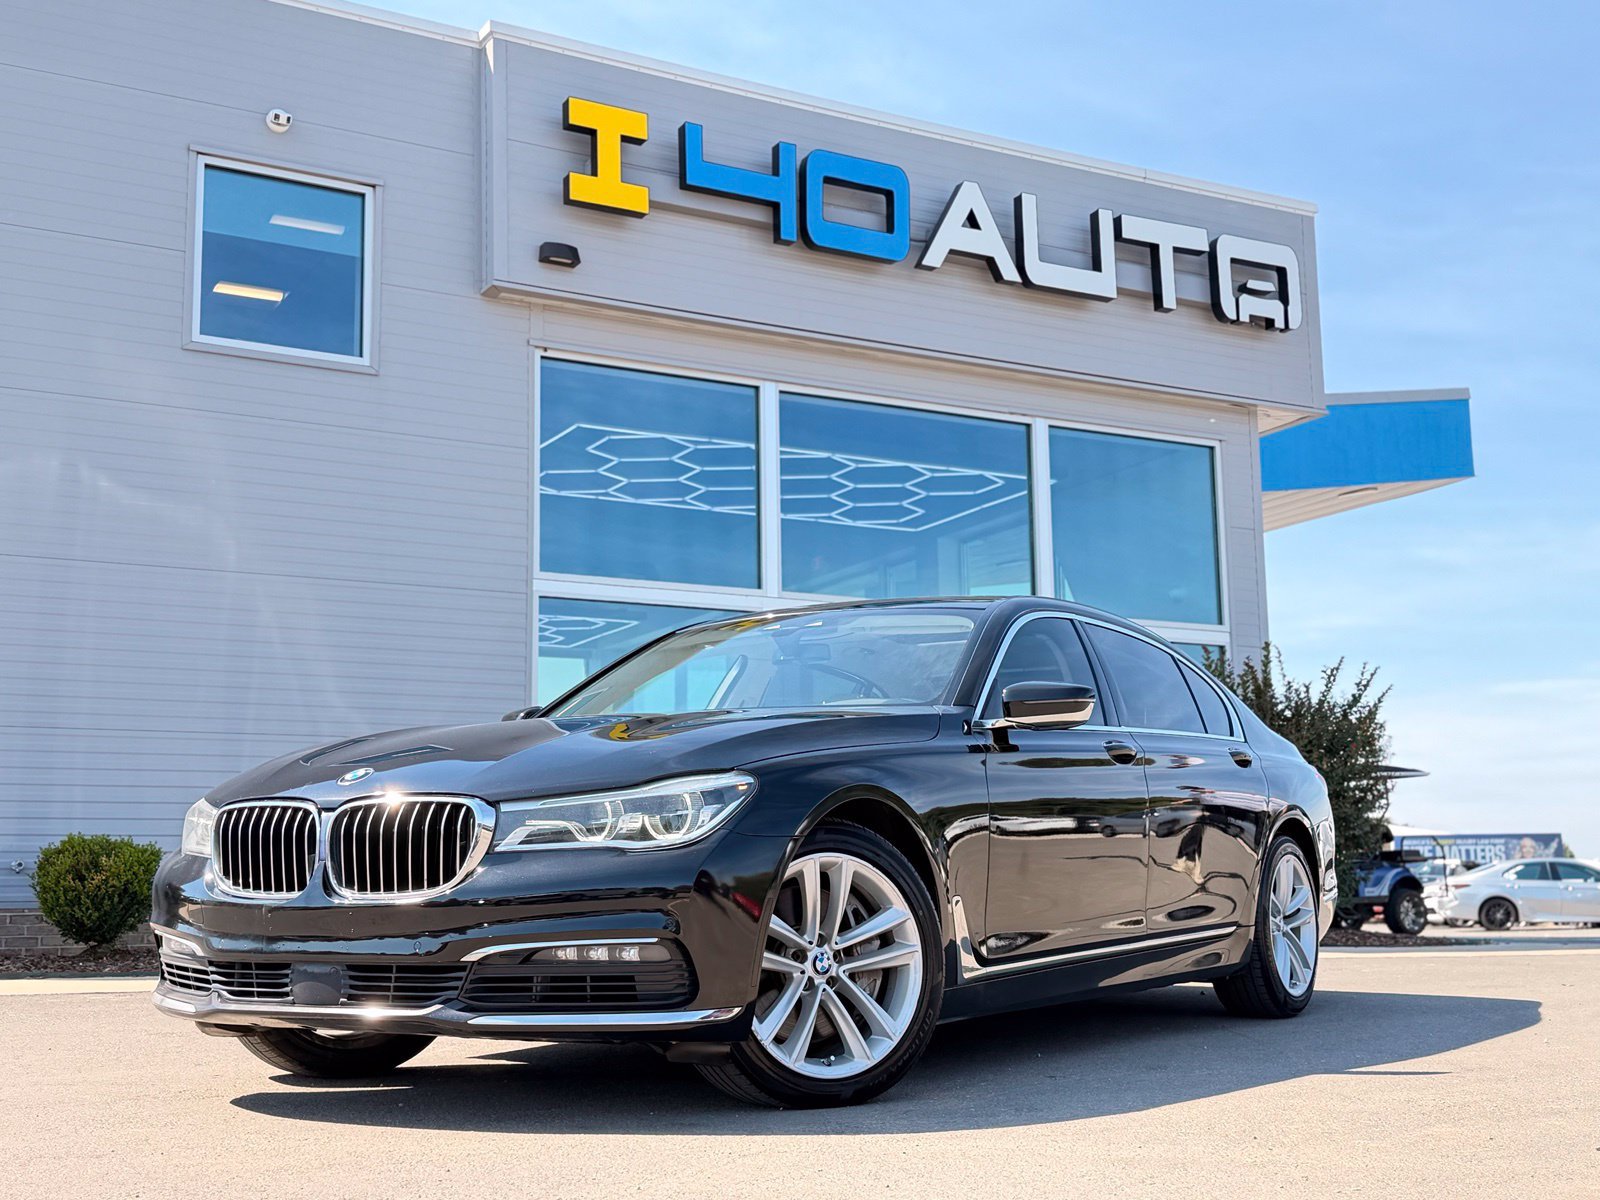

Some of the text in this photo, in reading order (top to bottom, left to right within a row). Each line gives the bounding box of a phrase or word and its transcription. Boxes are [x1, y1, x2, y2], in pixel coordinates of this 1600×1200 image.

[563, 96, 649, 218] I
[679, 121, 910, 264] 40
[1436, 845, 1506, 863] MATTERS
